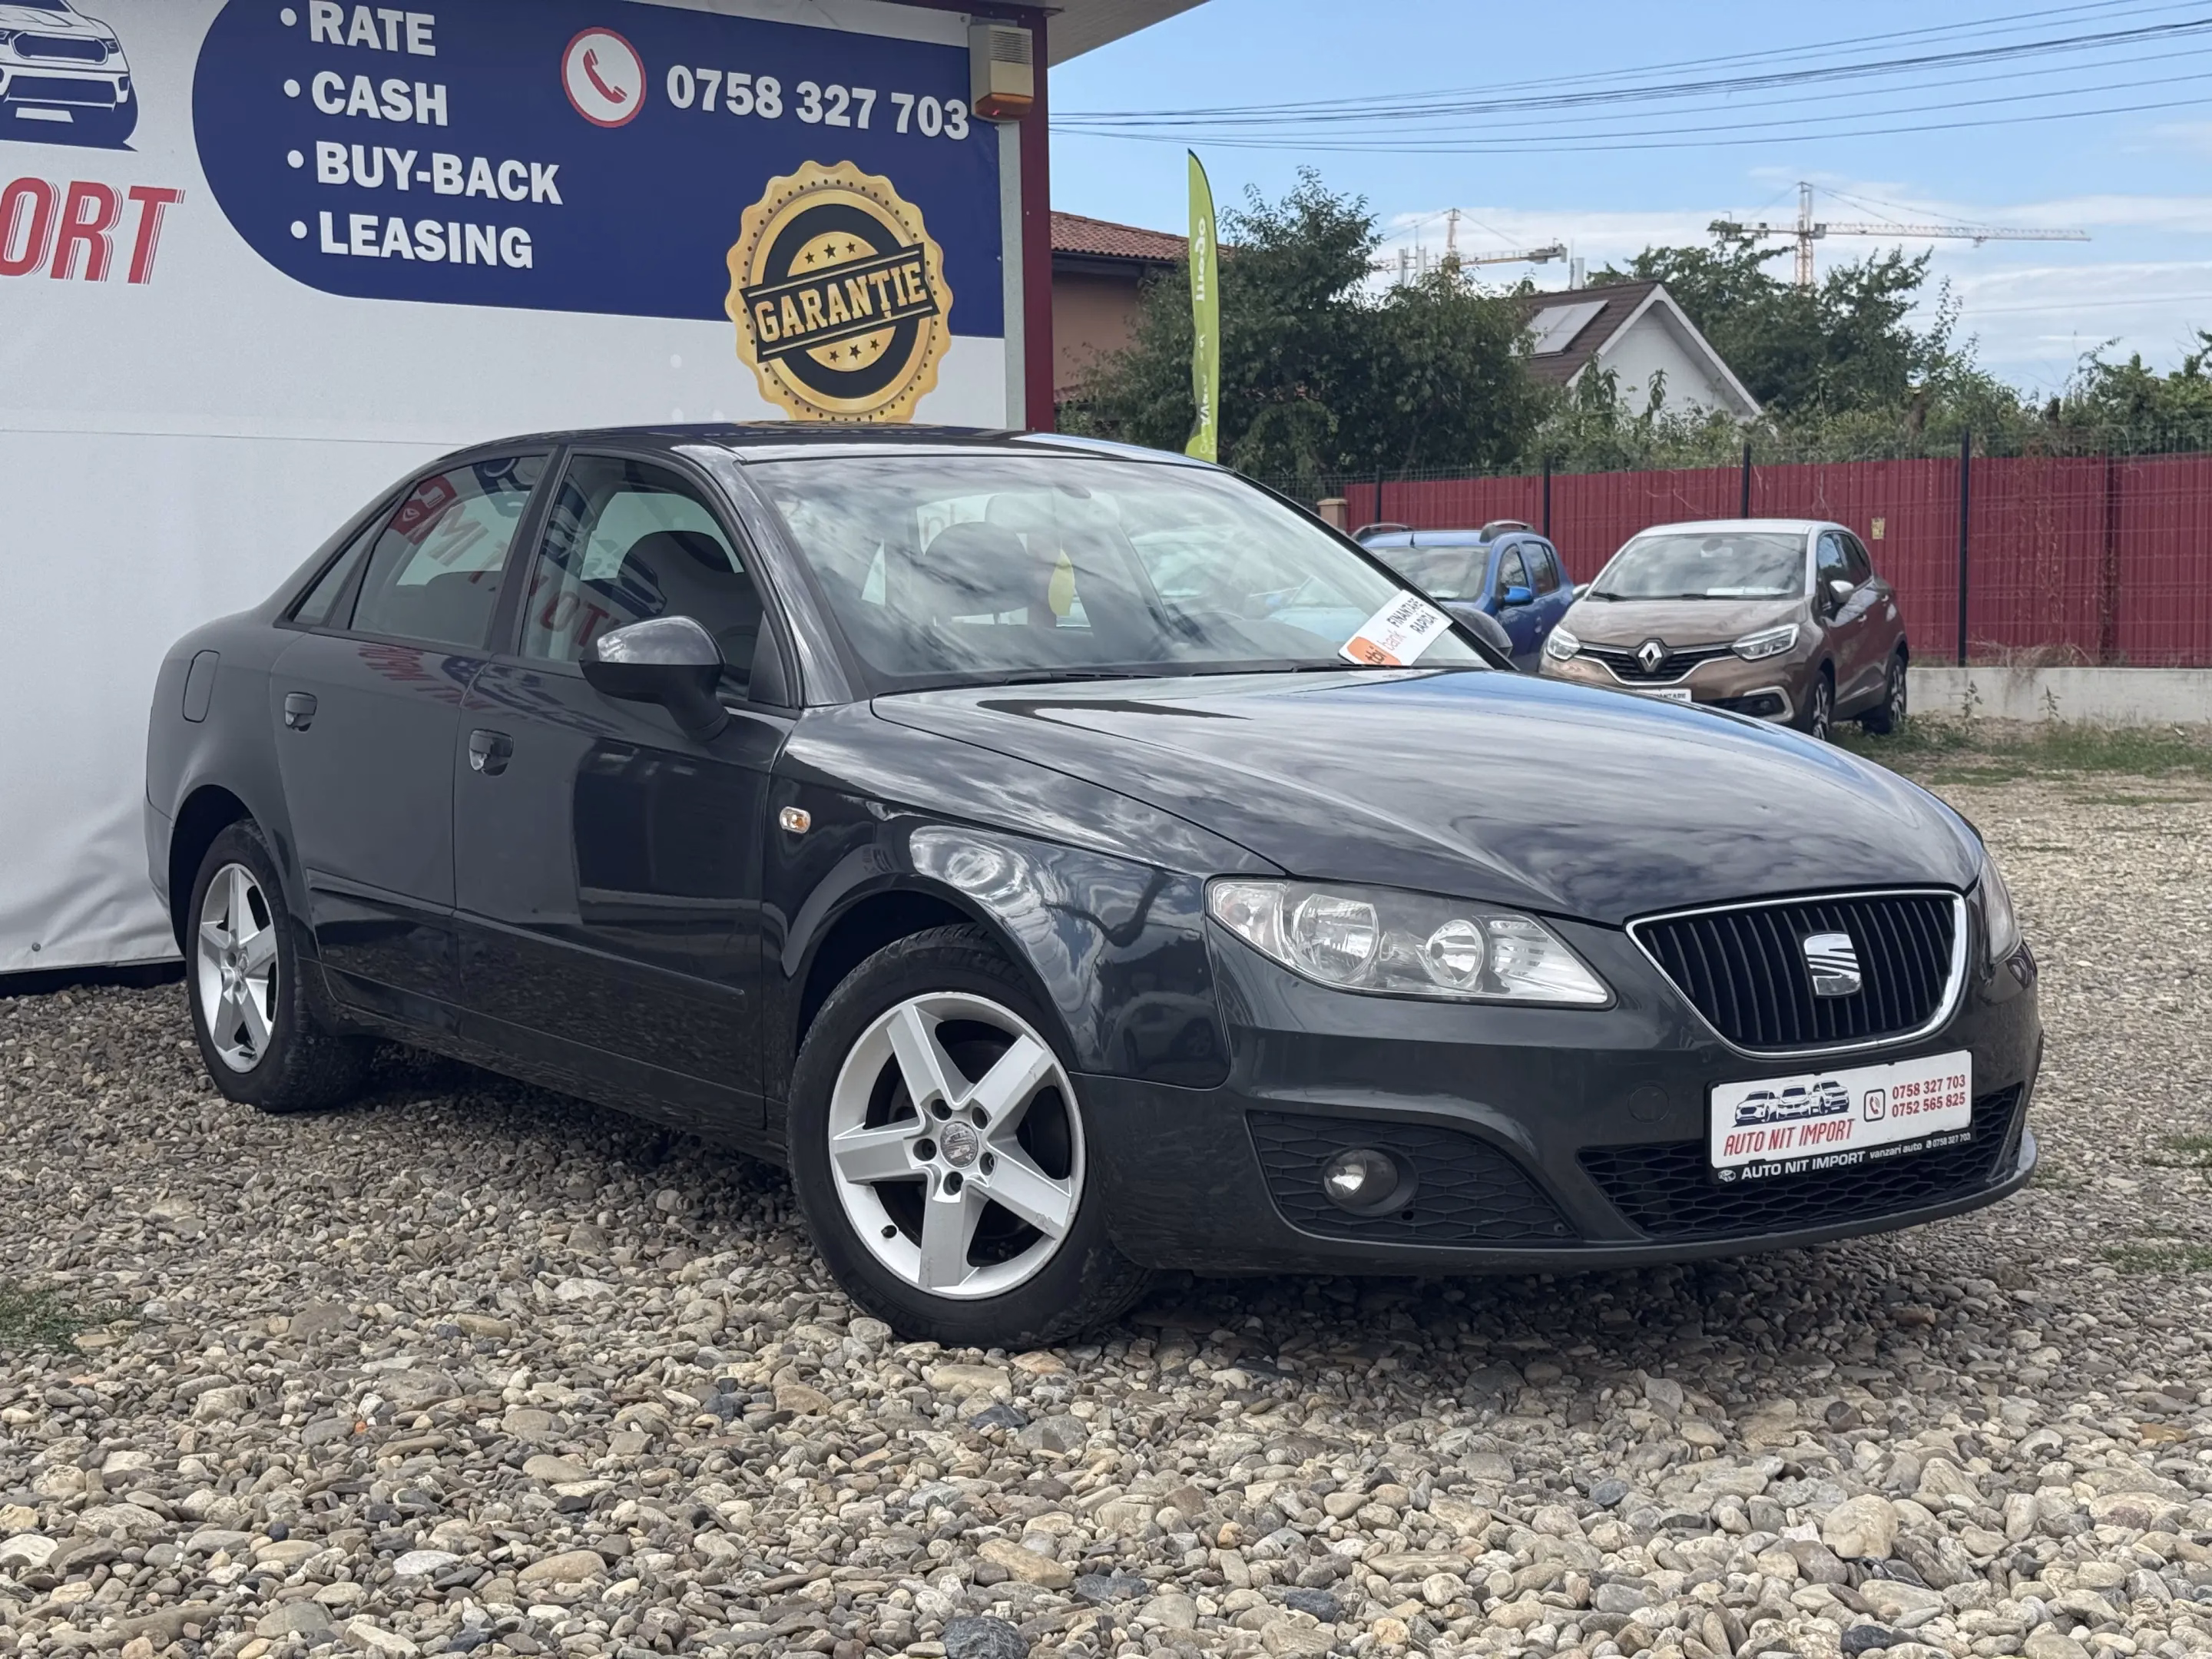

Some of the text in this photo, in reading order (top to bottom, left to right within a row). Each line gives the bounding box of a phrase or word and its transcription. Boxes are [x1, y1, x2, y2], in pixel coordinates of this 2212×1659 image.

[310, 1, 437, 56] RATE
[312, 71, 449, 126] CASH
[666, 65, 970, 140] 0758 327 703
[316, 141, 563, 205] BUY-BACK
[319, 211, 533, 269] LEASING
[1365, 629, 1407, 664] tbi bank
[1892, 1074, 1965, 1100] 0758 327 703
[1892, 1091, 1965, 1118] 0752 565 825
[1723, 1118, 1856, 1157] AUTO NIT IMPORT
[1740, 1163, 1782, 1180] AUTO
[1785, 1160, 1810, 1174] NIT
[1812, 1151, 1866, 1171] IMPORT
[1902, 1142, 1923, 1154] auto
